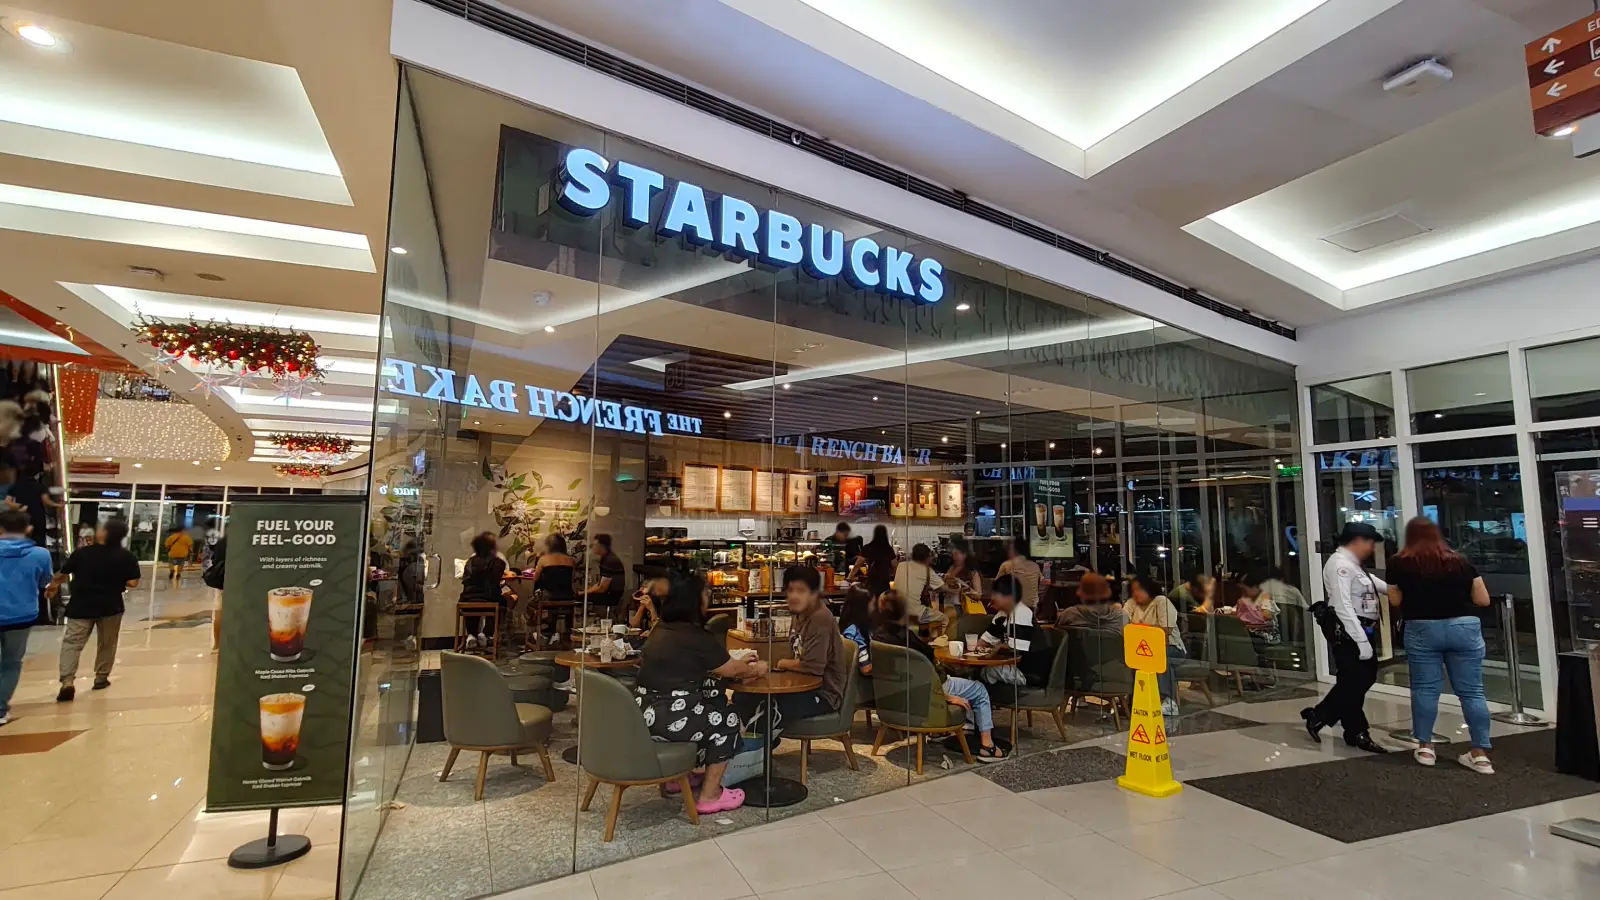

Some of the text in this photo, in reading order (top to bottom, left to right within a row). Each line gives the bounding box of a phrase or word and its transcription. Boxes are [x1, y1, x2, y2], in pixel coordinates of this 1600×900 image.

[562, 148, 944, 303] STARBUCKS
[256, 520, 335, 531] FUEL YOUR
[252, 534, 337, 546] FEEL-GOOD
[1133, 708, 1148, 717] CAUTION
